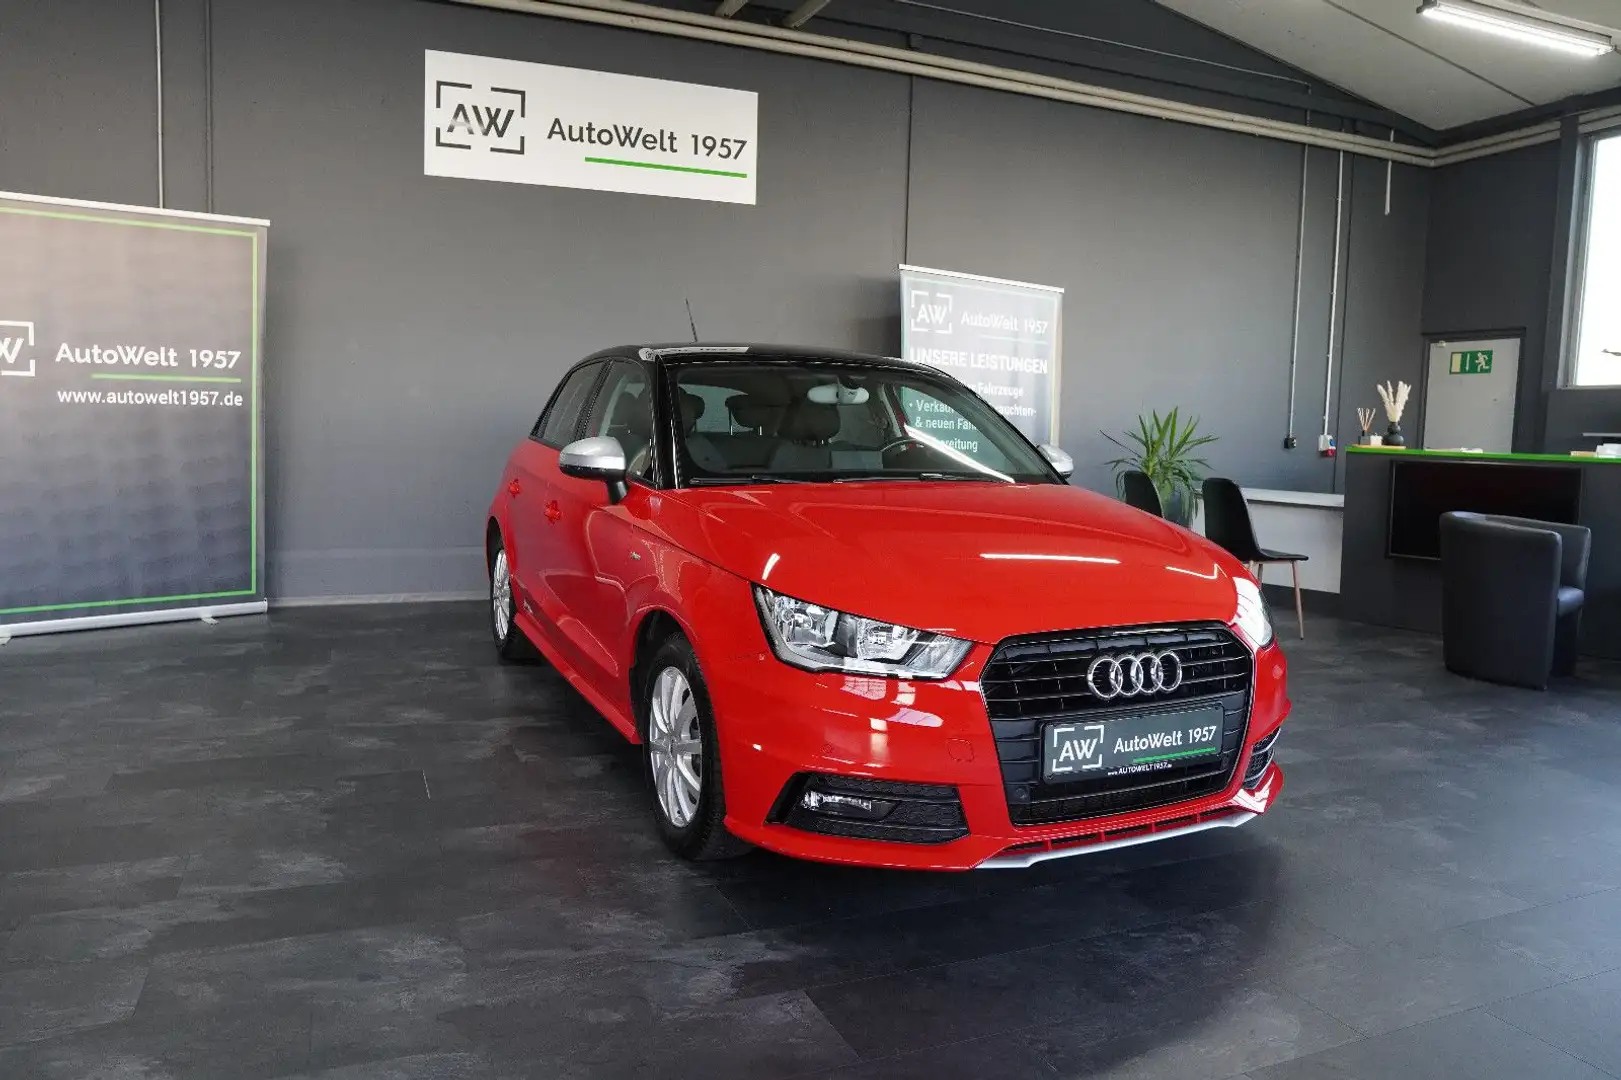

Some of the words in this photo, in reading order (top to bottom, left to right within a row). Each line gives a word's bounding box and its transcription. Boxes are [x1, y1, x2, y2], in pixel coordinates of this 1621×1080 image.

[447, 103, 515, 138] AW
[547, 117, 678, 153] AutoWelt
[691, 134, 748, 160] 1957
[916, 303, 947, 325] AW
[961, 311, 1019, 332] AutoWelt
[1024, 319, 1049, 334] 1957
[55, 342, 178, 367] AutoWelt
[189, 349, 241, 368] 1957
[910, 347, 967, 367] UNSERE
[970, 353, 1048, 374] LEISTUNGEN
[57, 388, 243, 406] www.autowelt1957.de
[978, 381, 1024, 398] Fahrzeuge
[916, 399, 953, 413] Verkau
[915, 417, 922, 427] &
[926, 419, 954, 429] neuen
[1059, 738, 1098, 762] AW
[1113, 732, 1182, 754] AutoWelt
[1188, 726, 1217, 743] 1957
